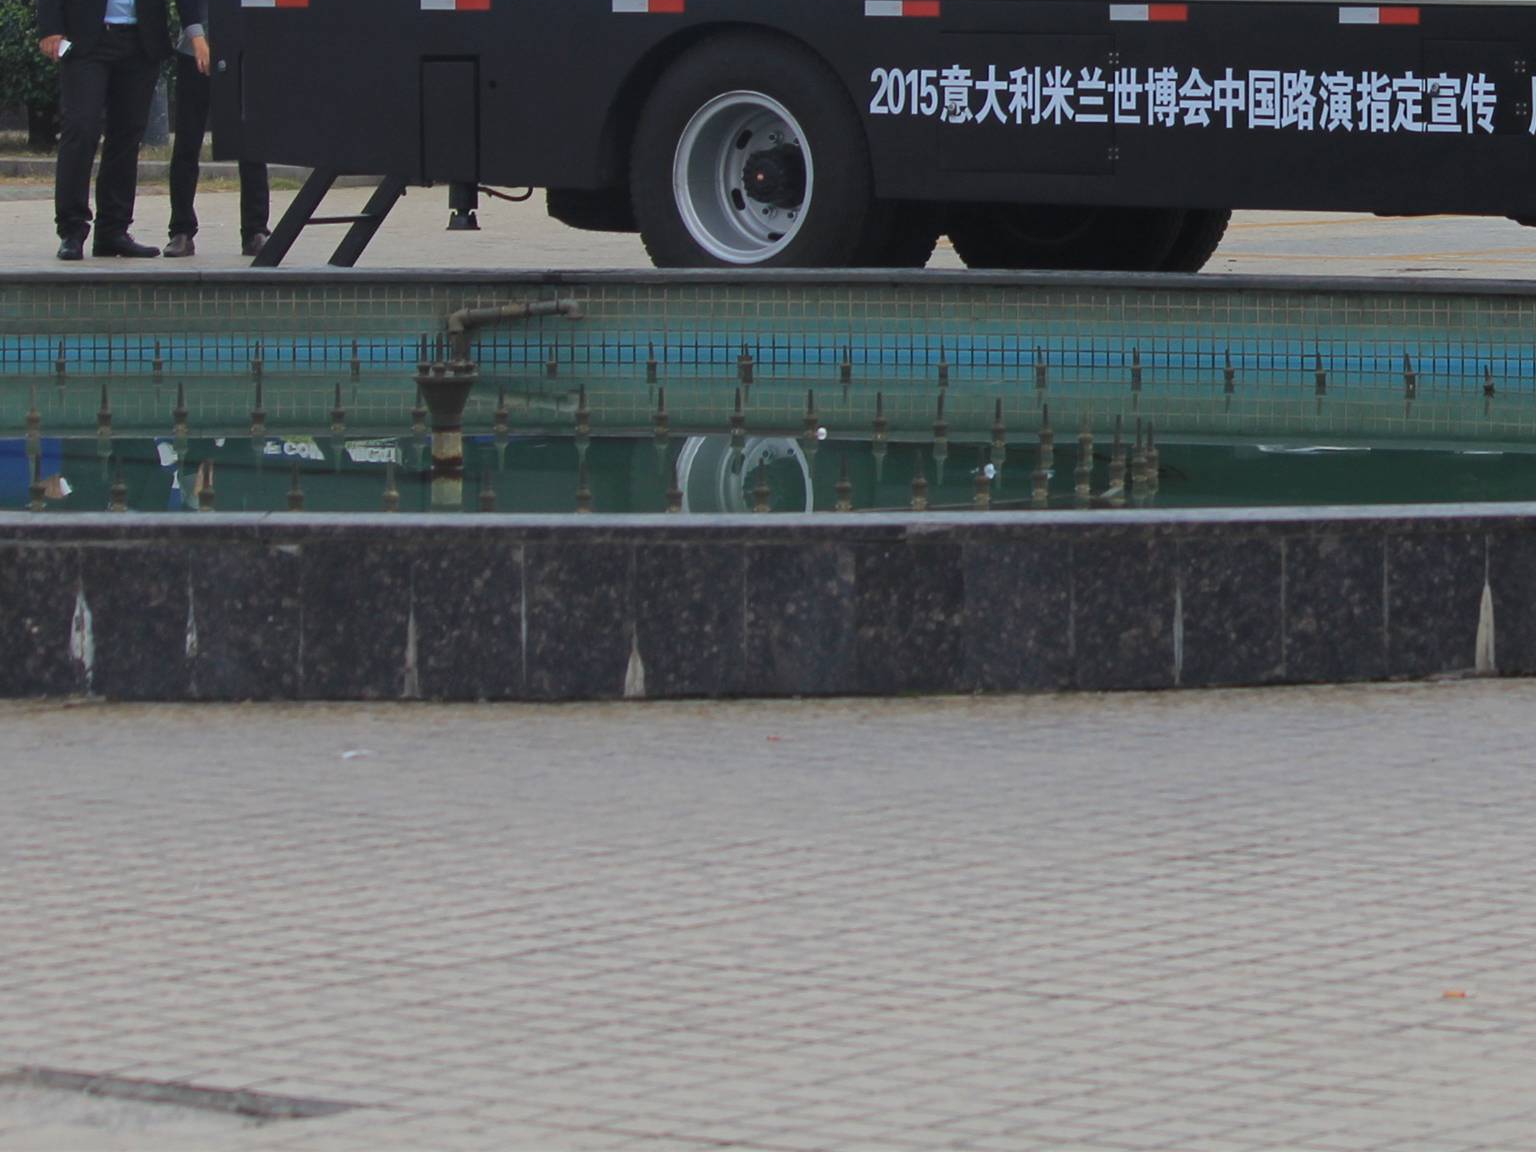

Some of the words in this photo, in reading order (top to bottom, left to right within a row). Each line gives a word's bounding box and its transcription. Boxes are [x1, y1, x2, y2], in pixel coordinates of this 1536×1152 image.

[869, 64, 1498, 134] 2015意大利米兰世博会中国路演指定宣传
